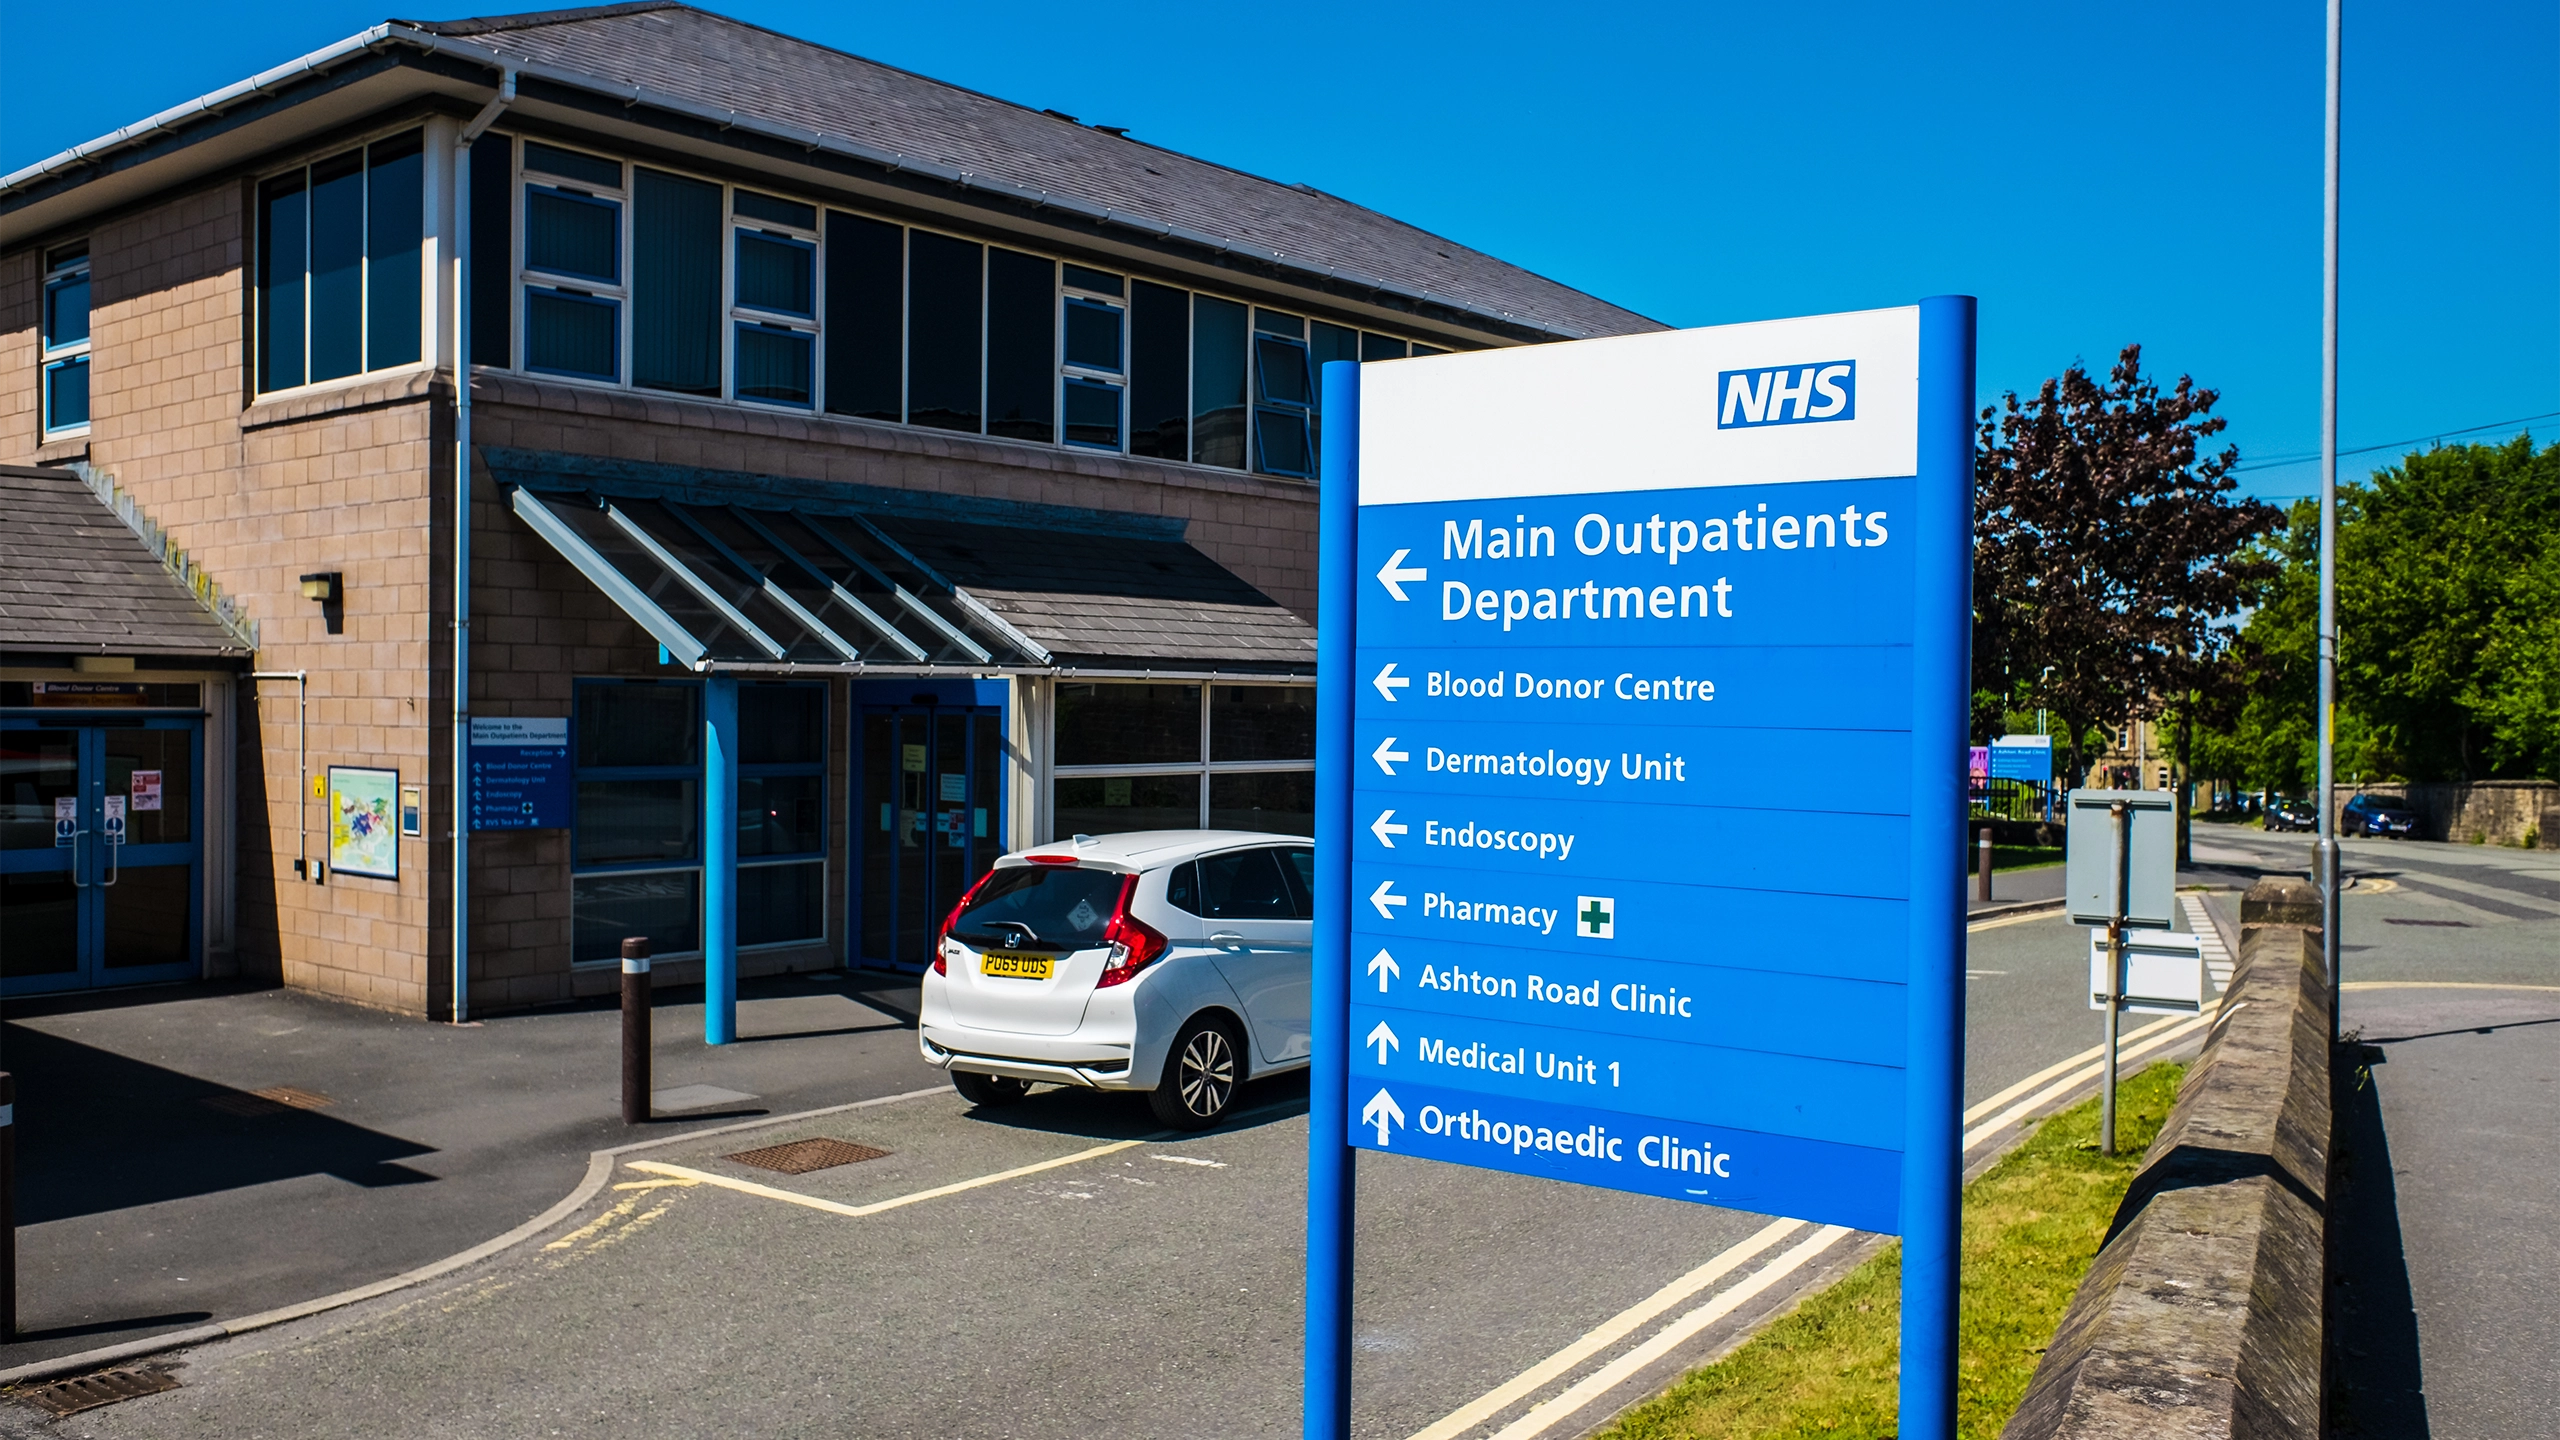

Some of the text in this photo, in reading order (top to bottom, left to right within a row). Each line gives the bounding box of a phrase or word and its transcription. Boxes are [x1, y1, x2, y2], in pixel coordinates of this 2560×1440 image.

[1721, 364, 1852, 425] NHS
[1443, 503, 1889, 565] Main Outpatients
[1442, 576, 1733, 631] Department
[47, 684, 120, 692] Blood Donor Centre
[1427, 671, 1715, 702] Blood Donor Centre
[472, 723, 523, 731] Welcome to the
[472, 732, 567, 741] Main Outpatients Department
[486, 761, 552, 770] Blood Donor Centre
[520, 749, 553, 758] Reception
[1426, 748, 1686, 786] Dermatology Unit
[486, 776, 546, 785] Dermatology Unit
[486, 790, 523, 799] Endoscopy
[485, 804, 519, 813] Pharmacy
[501, 818, 512, 826] Tea
[513, 818, 525, 826] Bar
[1425, 821, 1575, 861] Endoscopy
[1423, 892, 1558, 935] Pharmacy
[1022, 956, 1048, 975] UDS
[1419, 964, 1692, 1018] Ashton Road Clinic
[1419, 1037, 1620, 1088] Medical Unit 1
[1419, 1105, 1730, 1178] Orthopaedic Clinic
